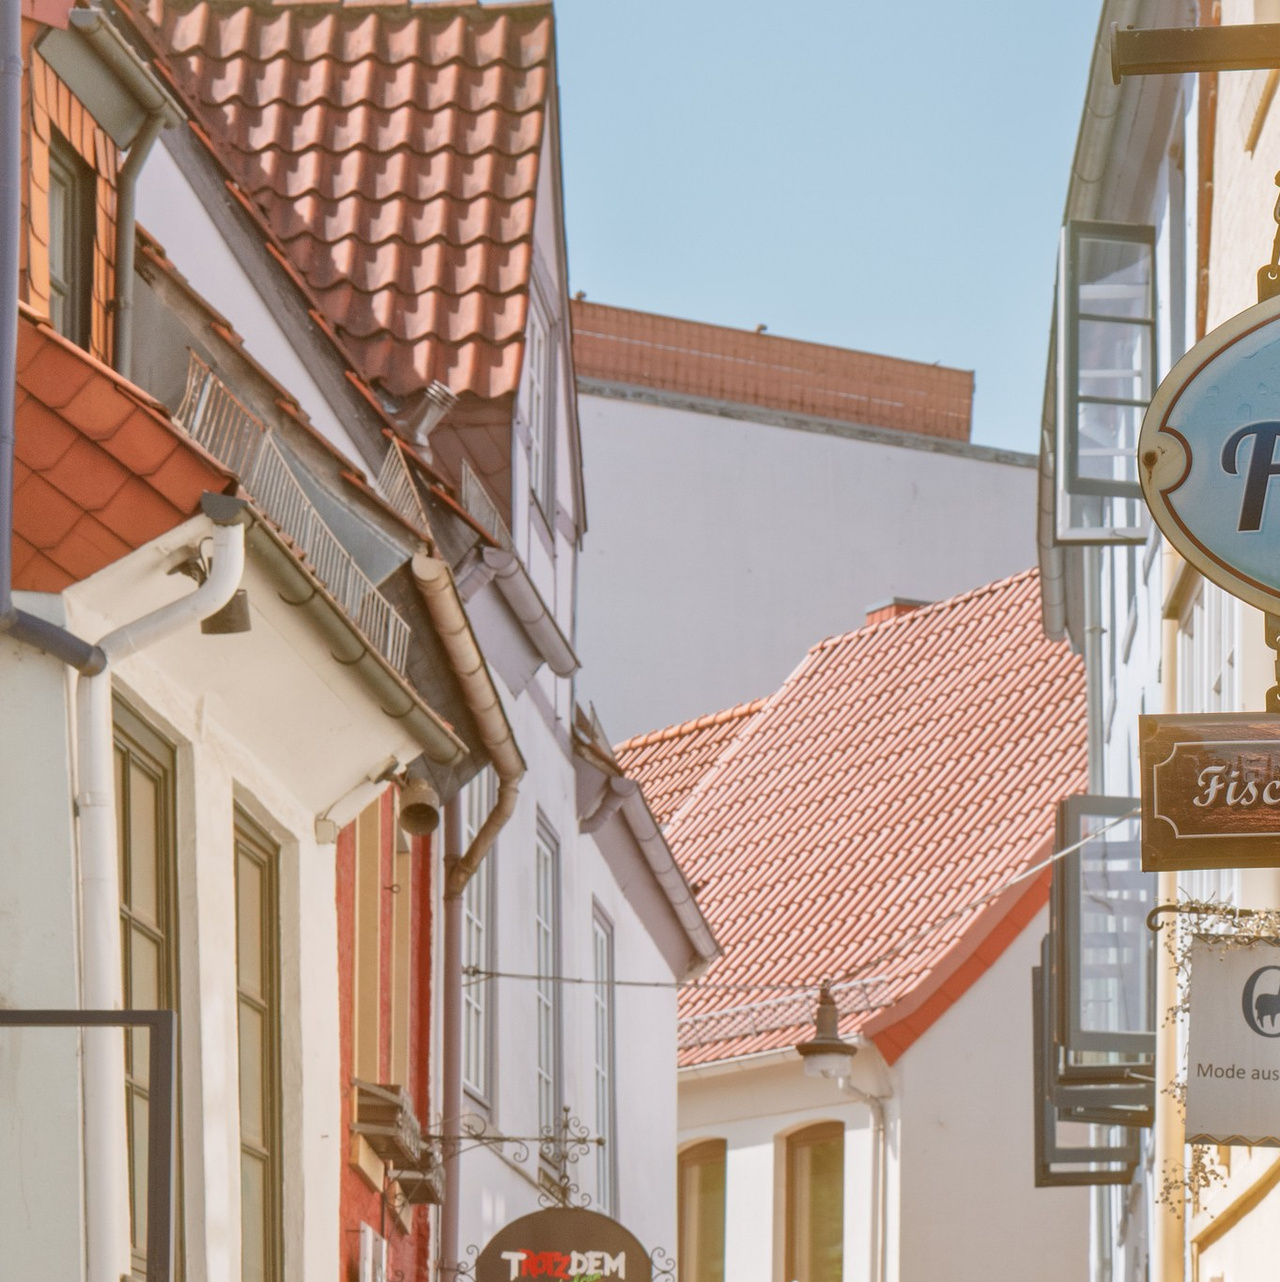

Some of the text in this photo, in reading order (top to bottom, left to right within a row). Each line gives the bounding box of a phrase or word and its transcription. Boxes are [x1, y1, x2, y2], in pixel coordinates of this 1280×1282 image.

[1196, 1062, 1246, 1081] Mode
[1250, 1067, 1280, 1082] aus
[501, 1249, 626, 1282] TROTZDEM
